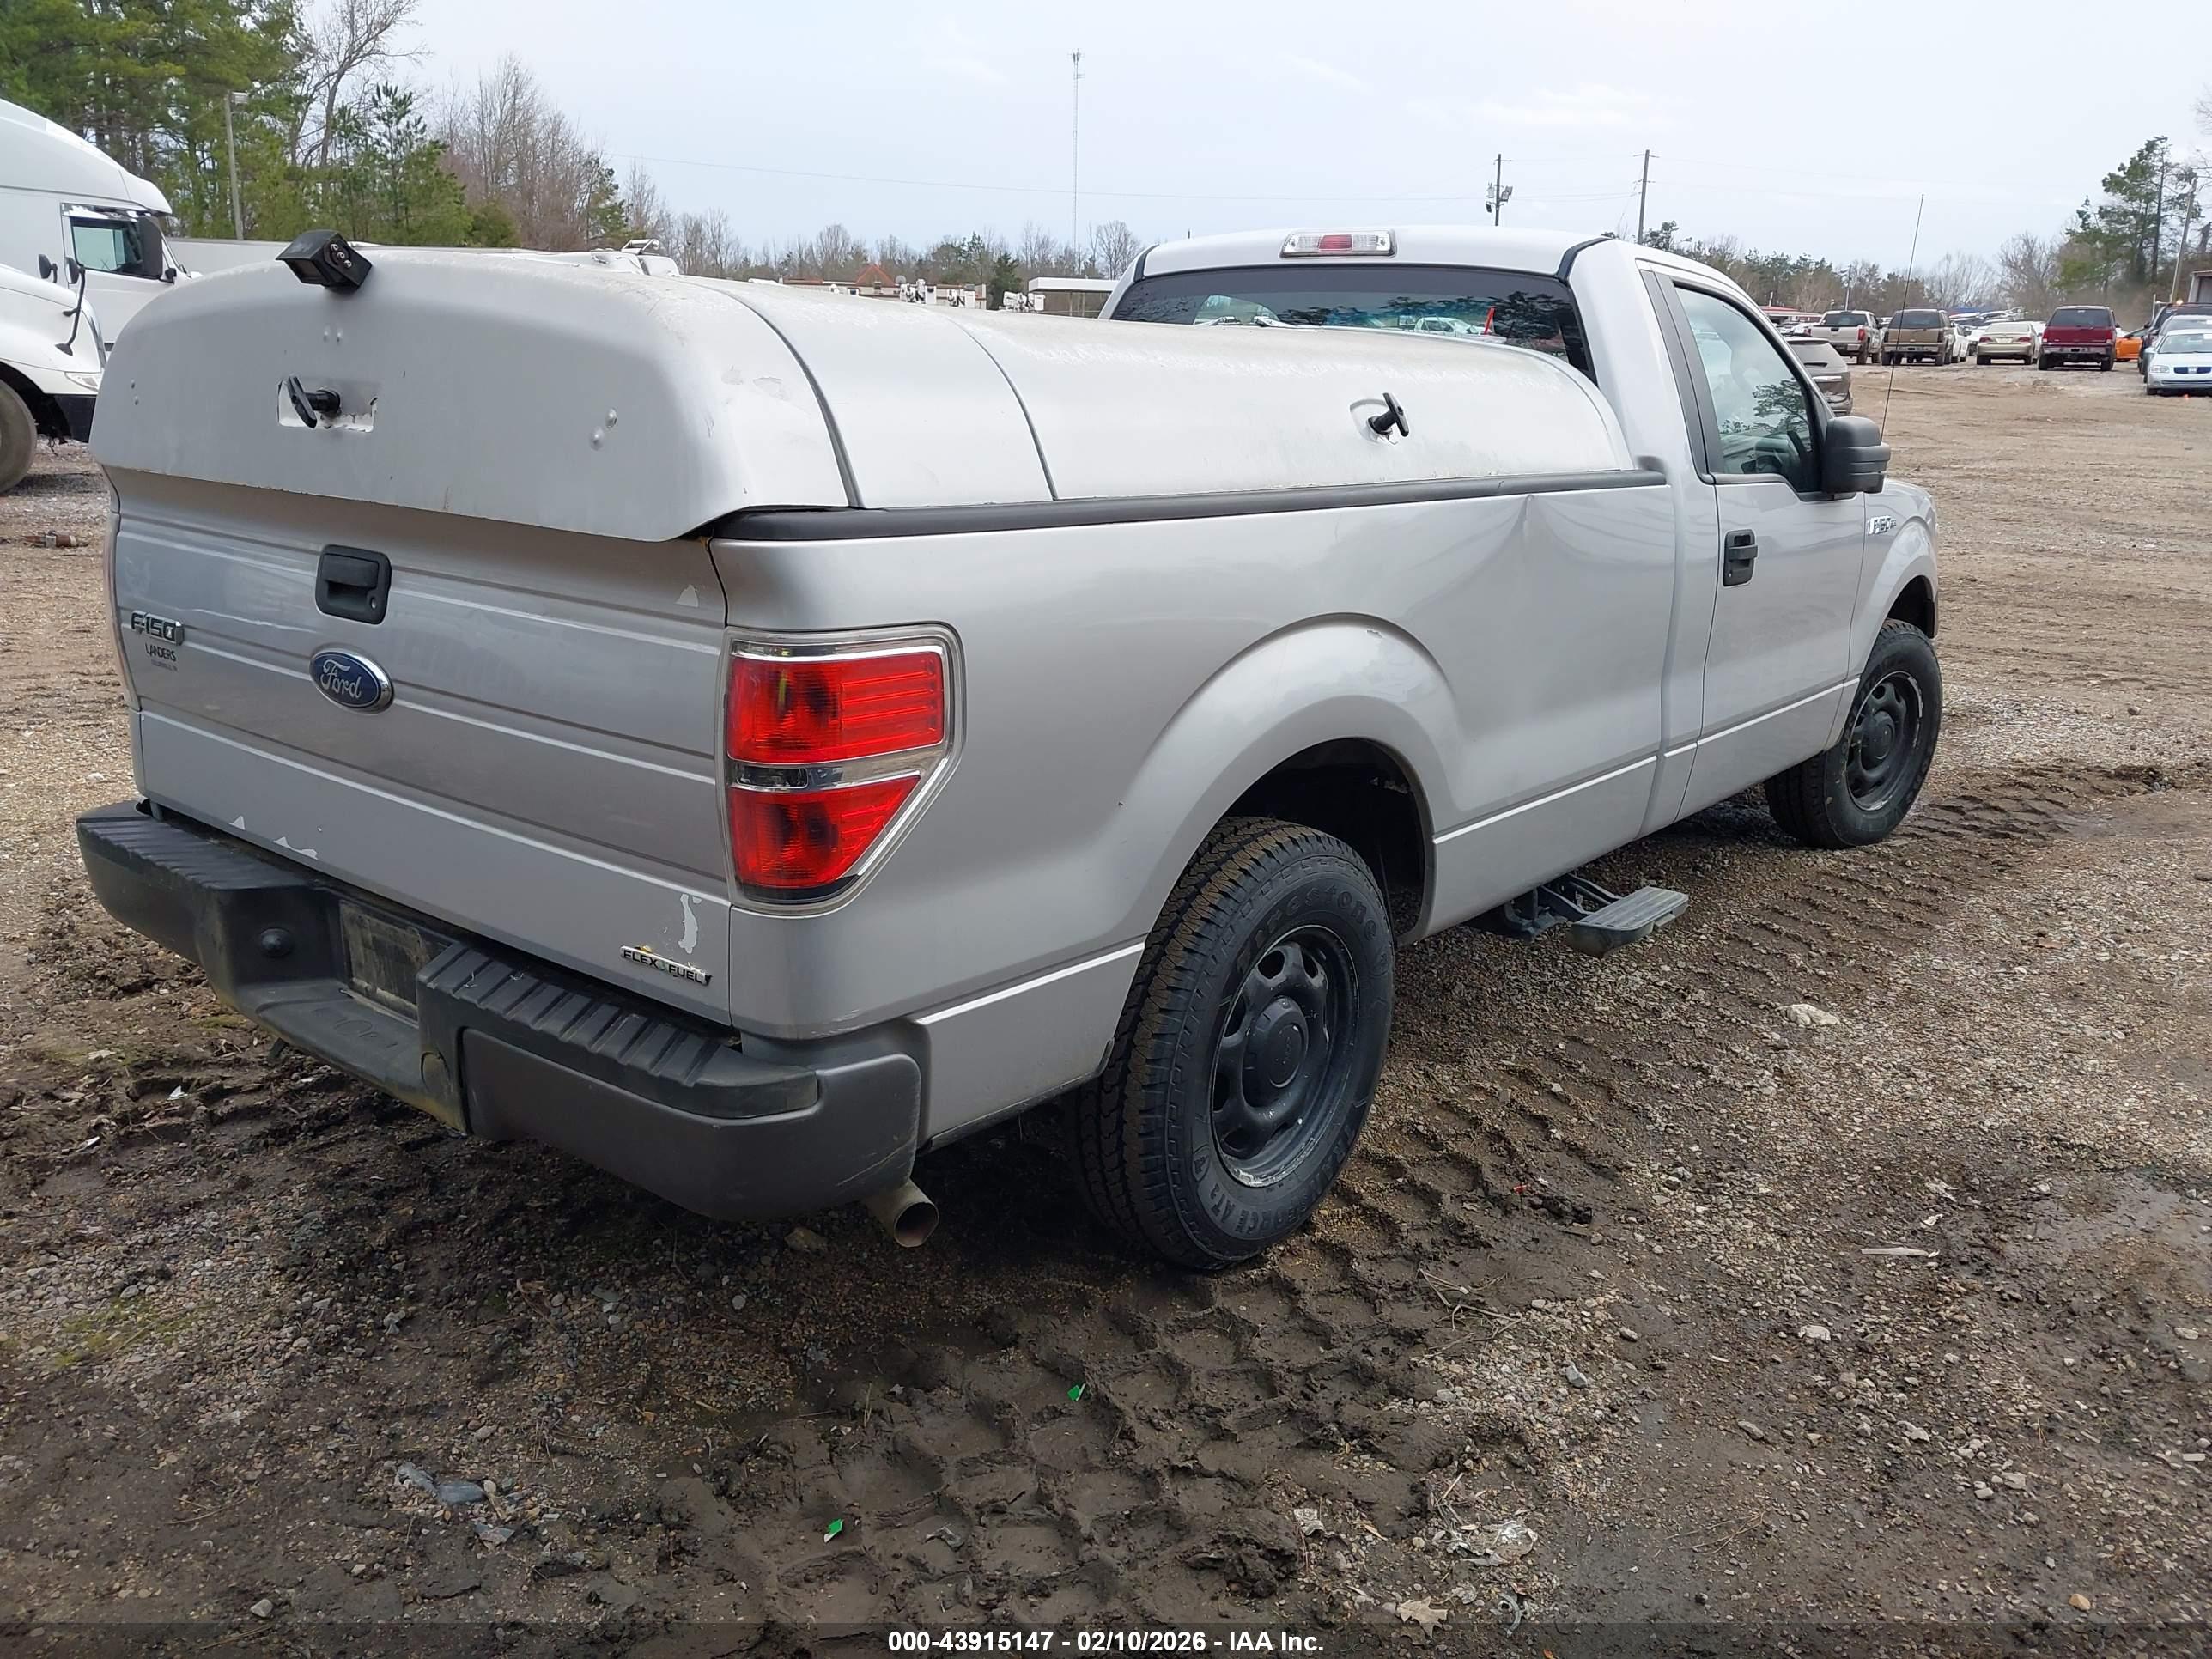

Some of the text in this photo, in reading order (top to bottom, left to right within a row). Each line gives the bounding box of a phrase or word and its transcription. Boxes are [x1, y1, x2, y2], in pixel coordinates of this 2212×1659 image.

[131, 611, 179, 644] F-150
[144, 642, 177, 662] LANDERS
[319, 659, 362, 699] Ford
[623, 948, 704, 985] FLEX FUEL
